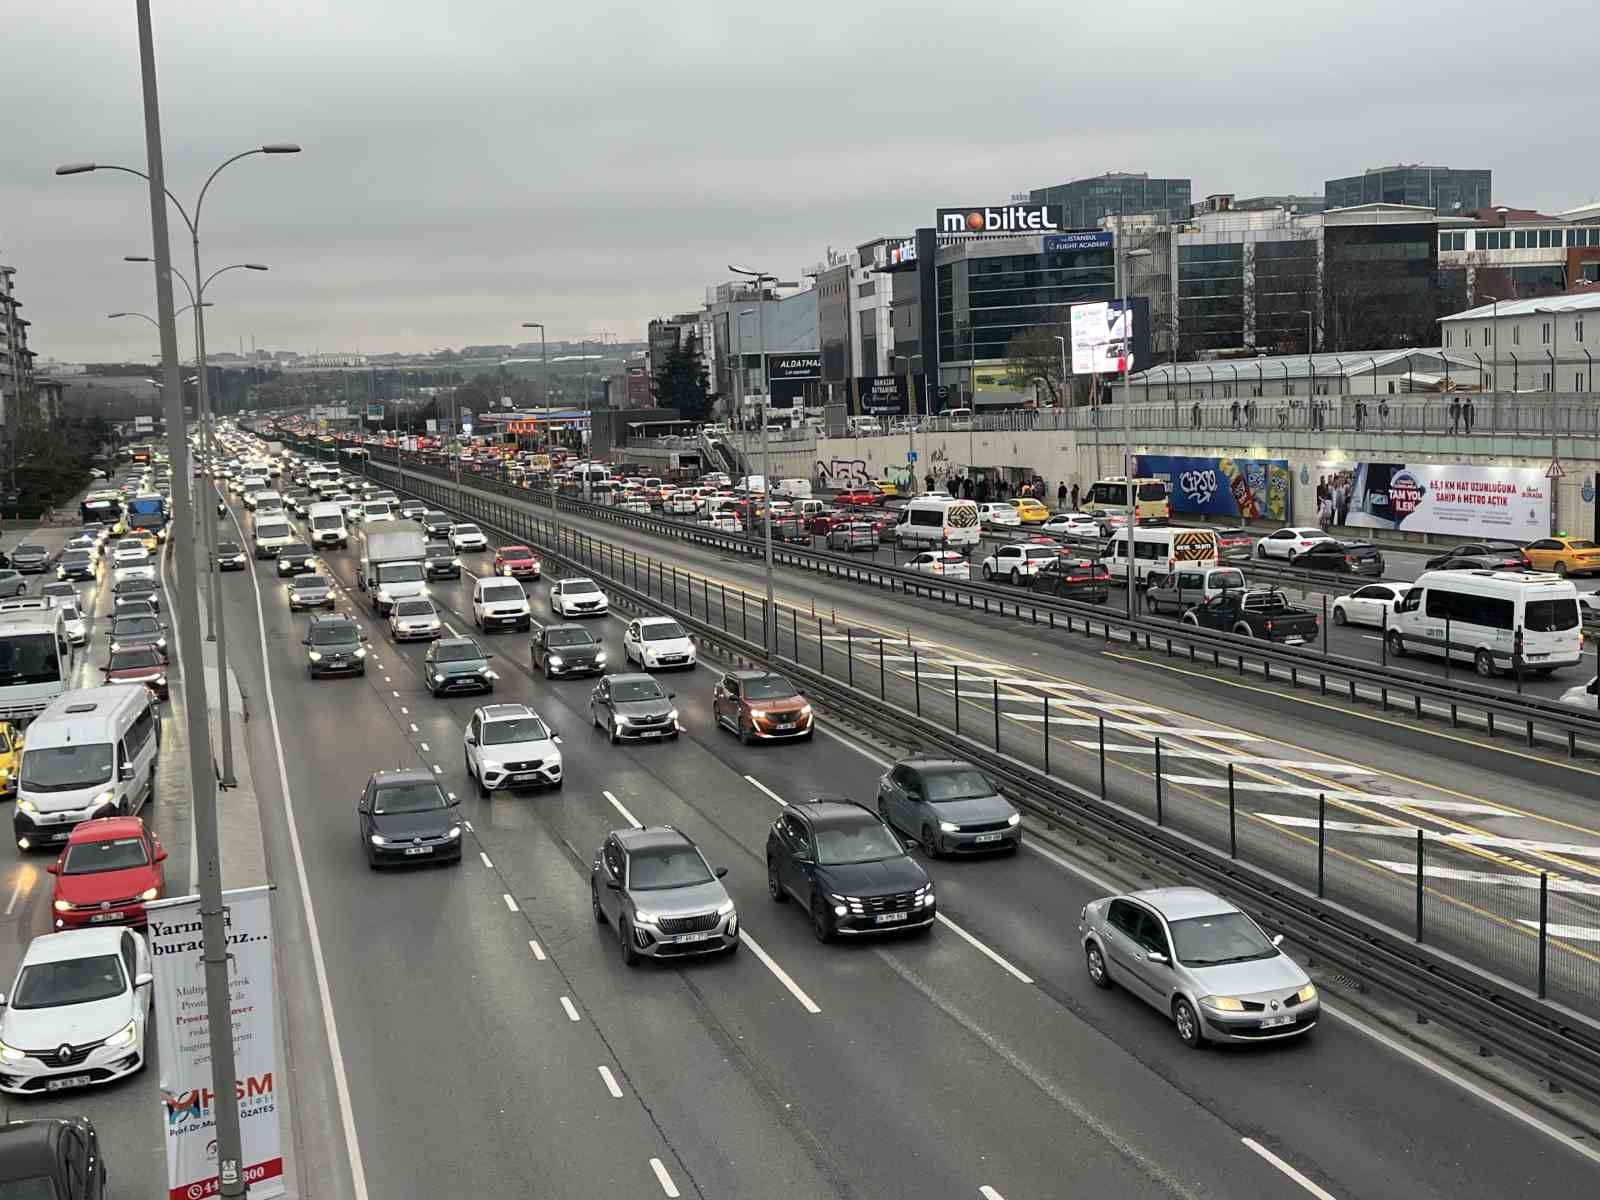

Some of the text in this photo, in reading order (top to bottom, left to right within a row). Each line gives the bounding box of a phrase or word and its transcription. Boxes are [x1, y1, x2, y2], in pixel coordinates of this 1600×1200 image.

[1444, 481, 1455, 490] KM
[1457, 481, 1469, 491] HAT
[1463, 494, 1486, 504] METRO
